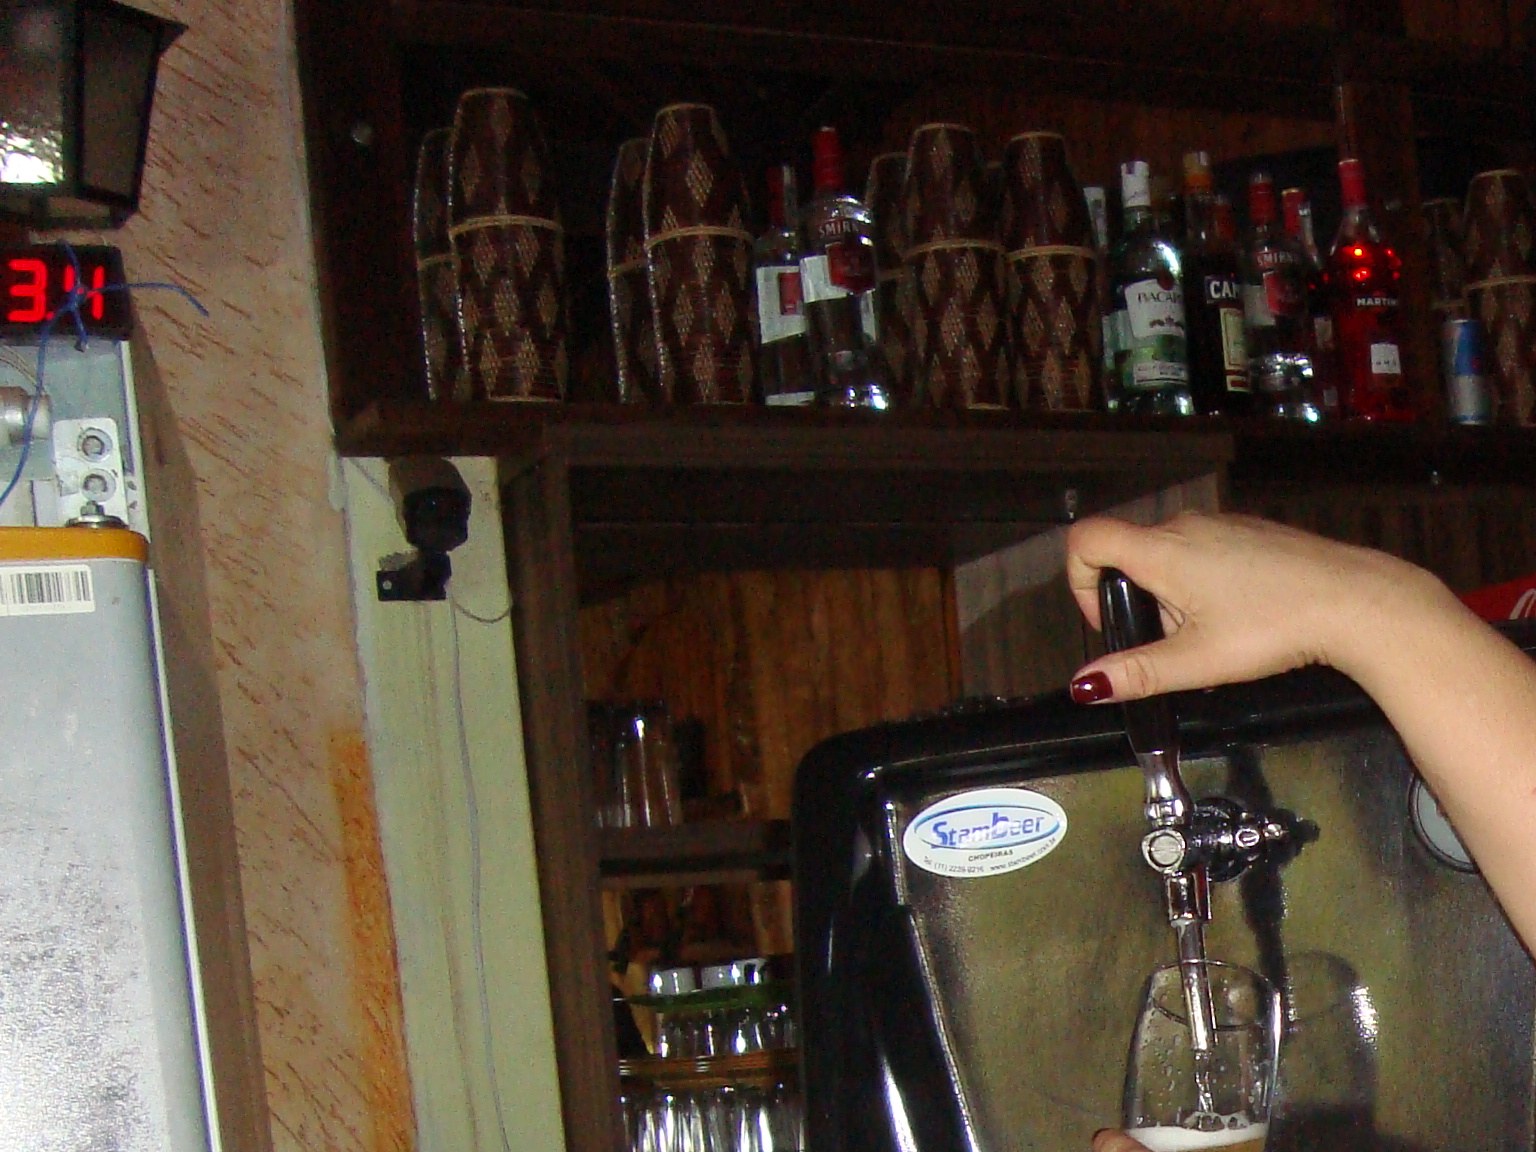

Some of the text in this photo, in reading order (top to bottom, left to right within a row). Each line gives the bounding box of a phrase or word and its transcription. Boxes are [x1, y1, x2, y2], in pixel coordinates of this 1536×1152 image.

[818, 219, 859, 239] SMIRN
[1137, 291, 1181, 304] BACAR
[1356, 297, 1398, 307] MARTIN
